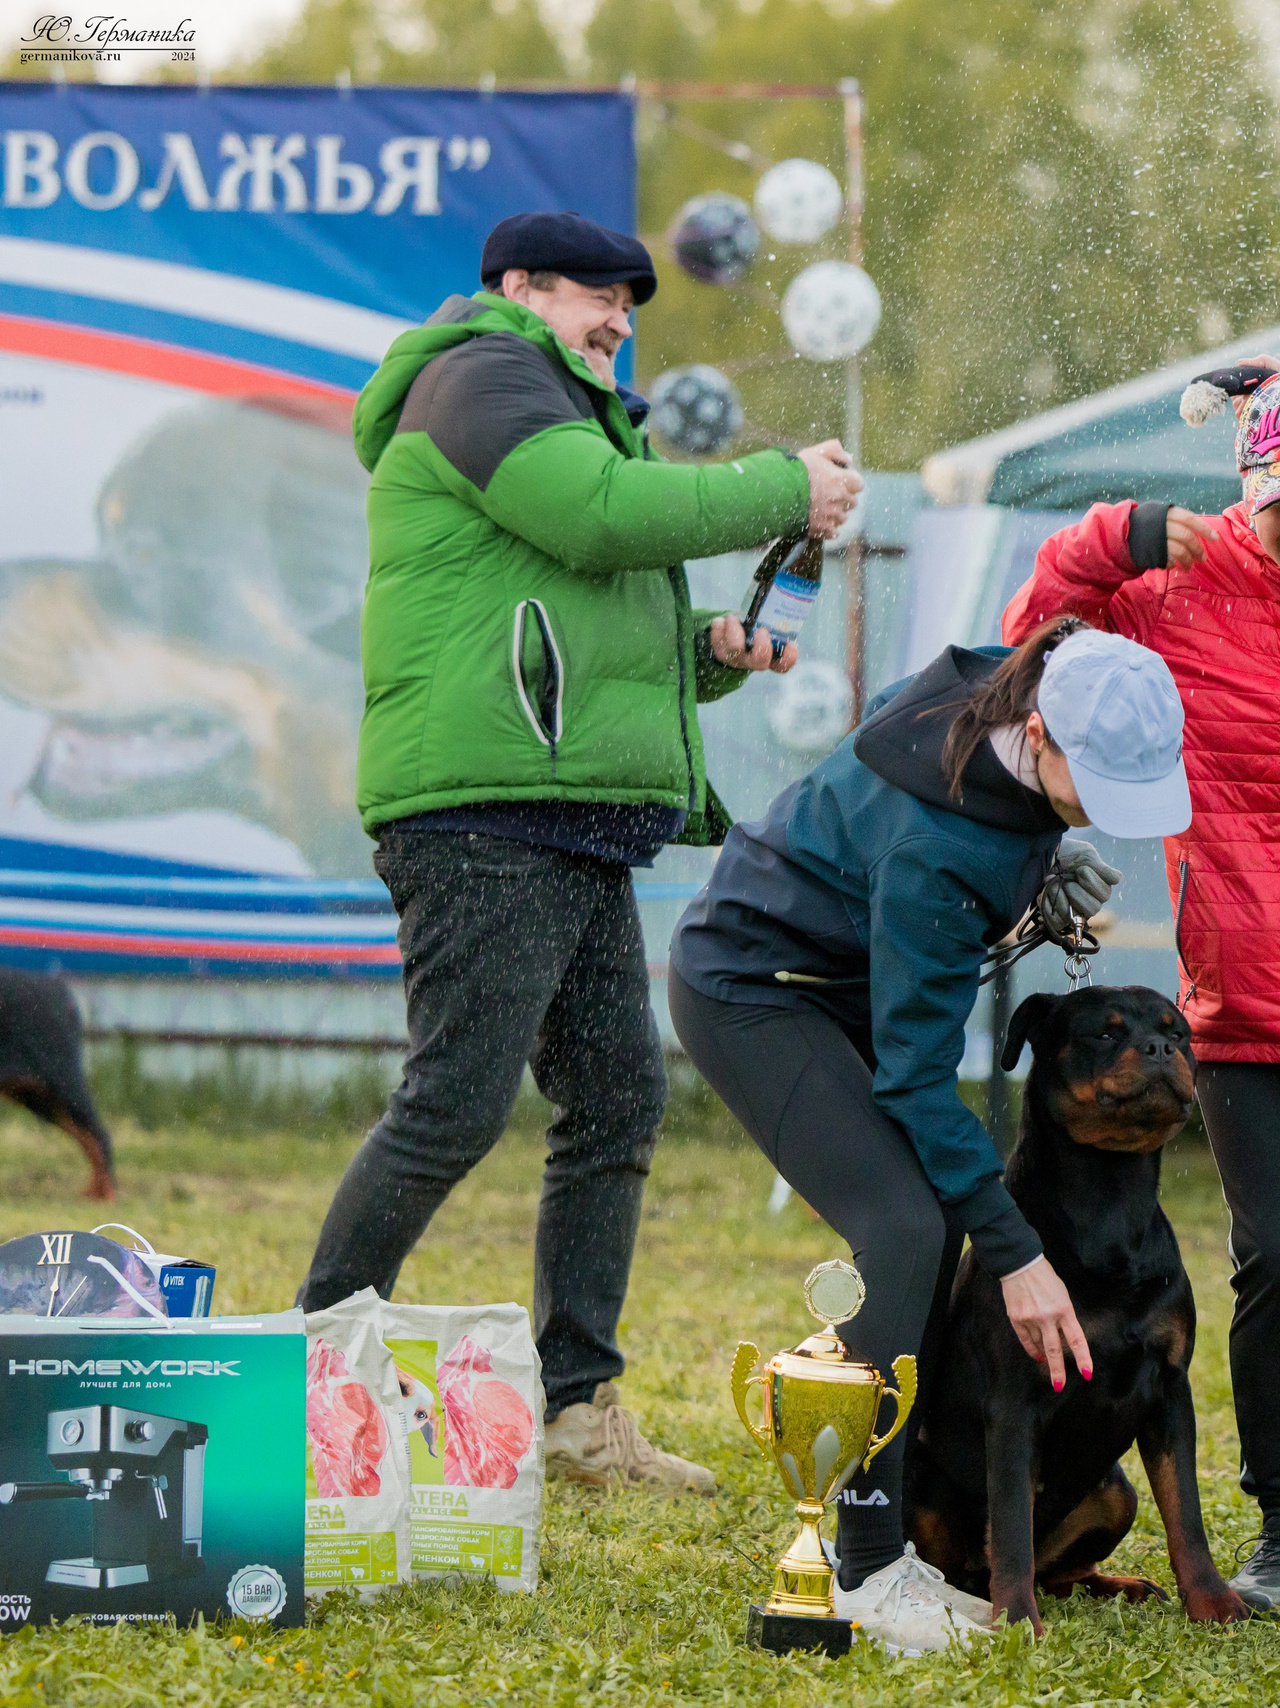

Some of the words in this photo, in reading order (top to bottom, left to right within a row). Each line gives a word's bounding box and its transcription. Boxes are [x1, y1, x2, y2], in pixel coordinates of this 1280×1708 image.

[37, 1233, 74, 1266] XII
[170, 1275, 186, 1286] VITEK
[9, 1359, 242, 1376] HOMEWORK
[414, 1534, 455, 1543] ВЗРОСЛЫХ
[433, 1543, 459, 1551] ПОРОД
[502, 1562, 509, 1571] 3
[510, 1563, 518, 1571] кг
[380, 1569, 386, 1577] 3
[242, 1584, 253, 1596] 15
[254, 1584, 272, 1596] BAR
[0, 1594, 32, 1604] ОСТЬ
[242, 1595, 272, 1603] ДАВЛЕНИЕ
